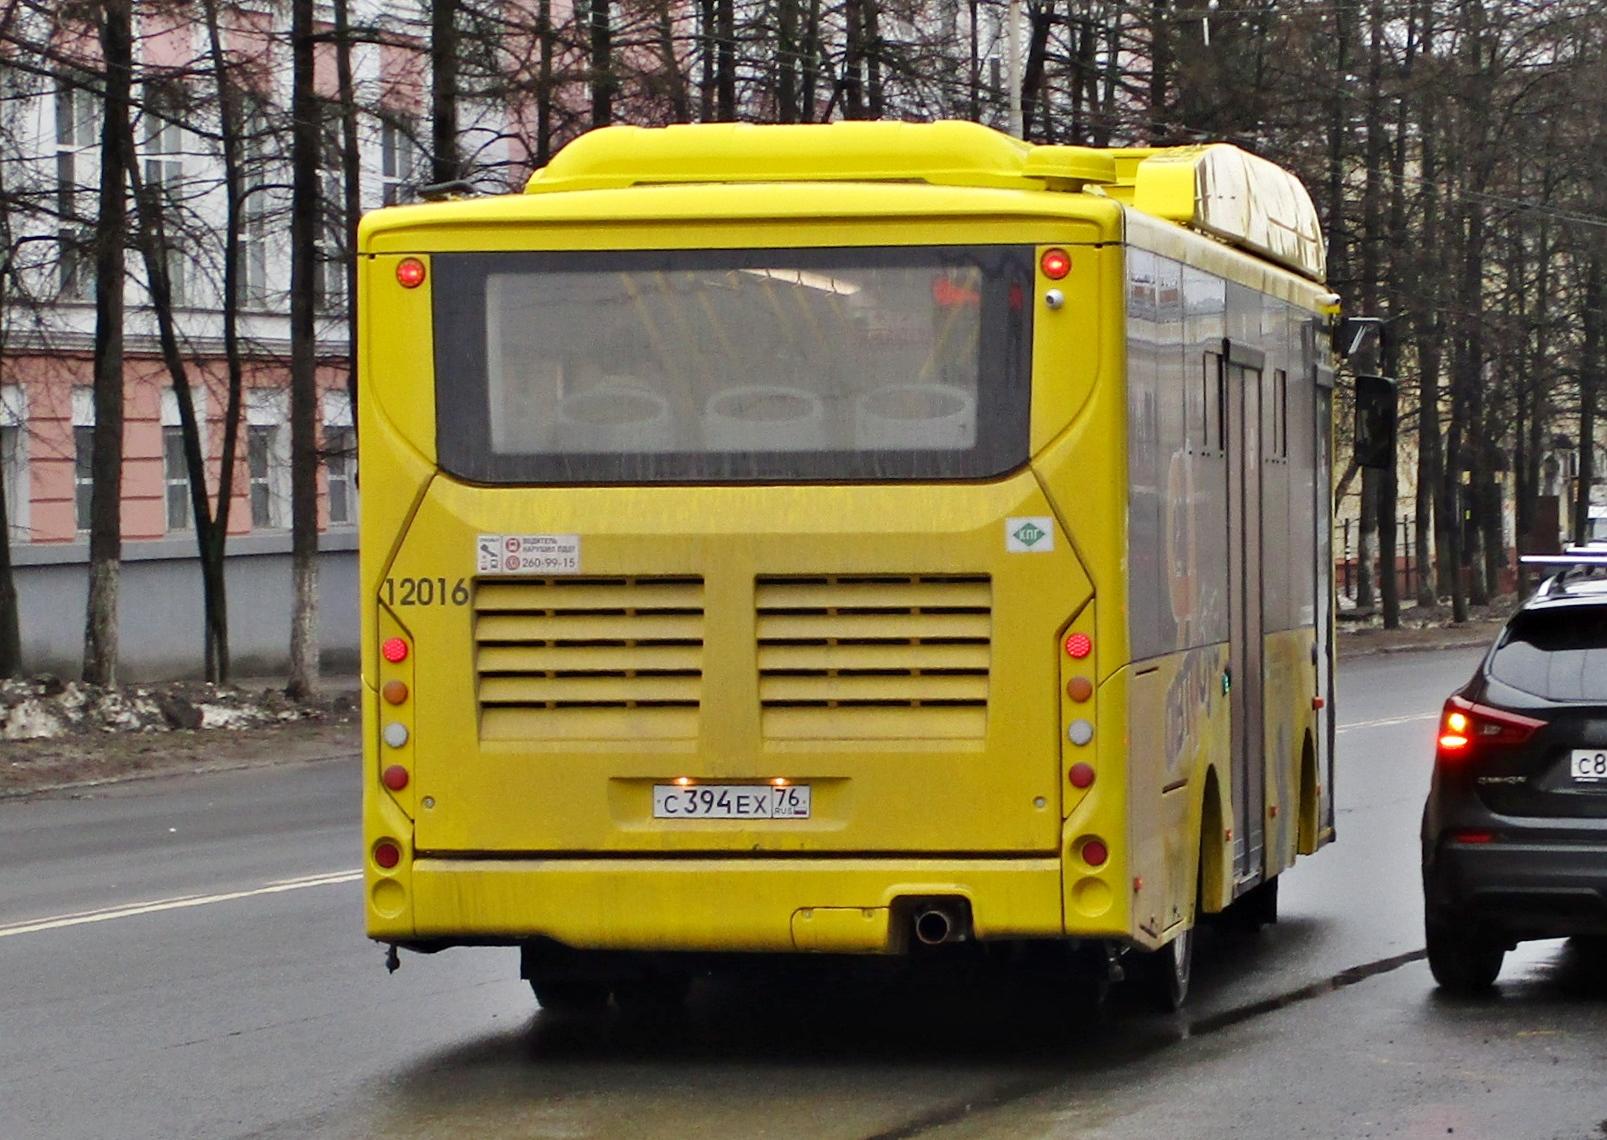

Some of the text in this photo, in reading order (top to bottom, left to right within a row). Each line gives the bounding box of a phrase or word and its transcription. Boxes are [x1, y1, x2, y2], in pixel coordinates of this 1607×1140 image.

[1019, 529, 1039, 540] КПГ
[522, 537, 558, 545] ВОДИТЕЛЬ
[521, 558, 576, 568] 260-99-15
[385, 577, 469, 606] 12016
[775, 788, 800, 807] 76
[774, 807, 793, 815] RUS
